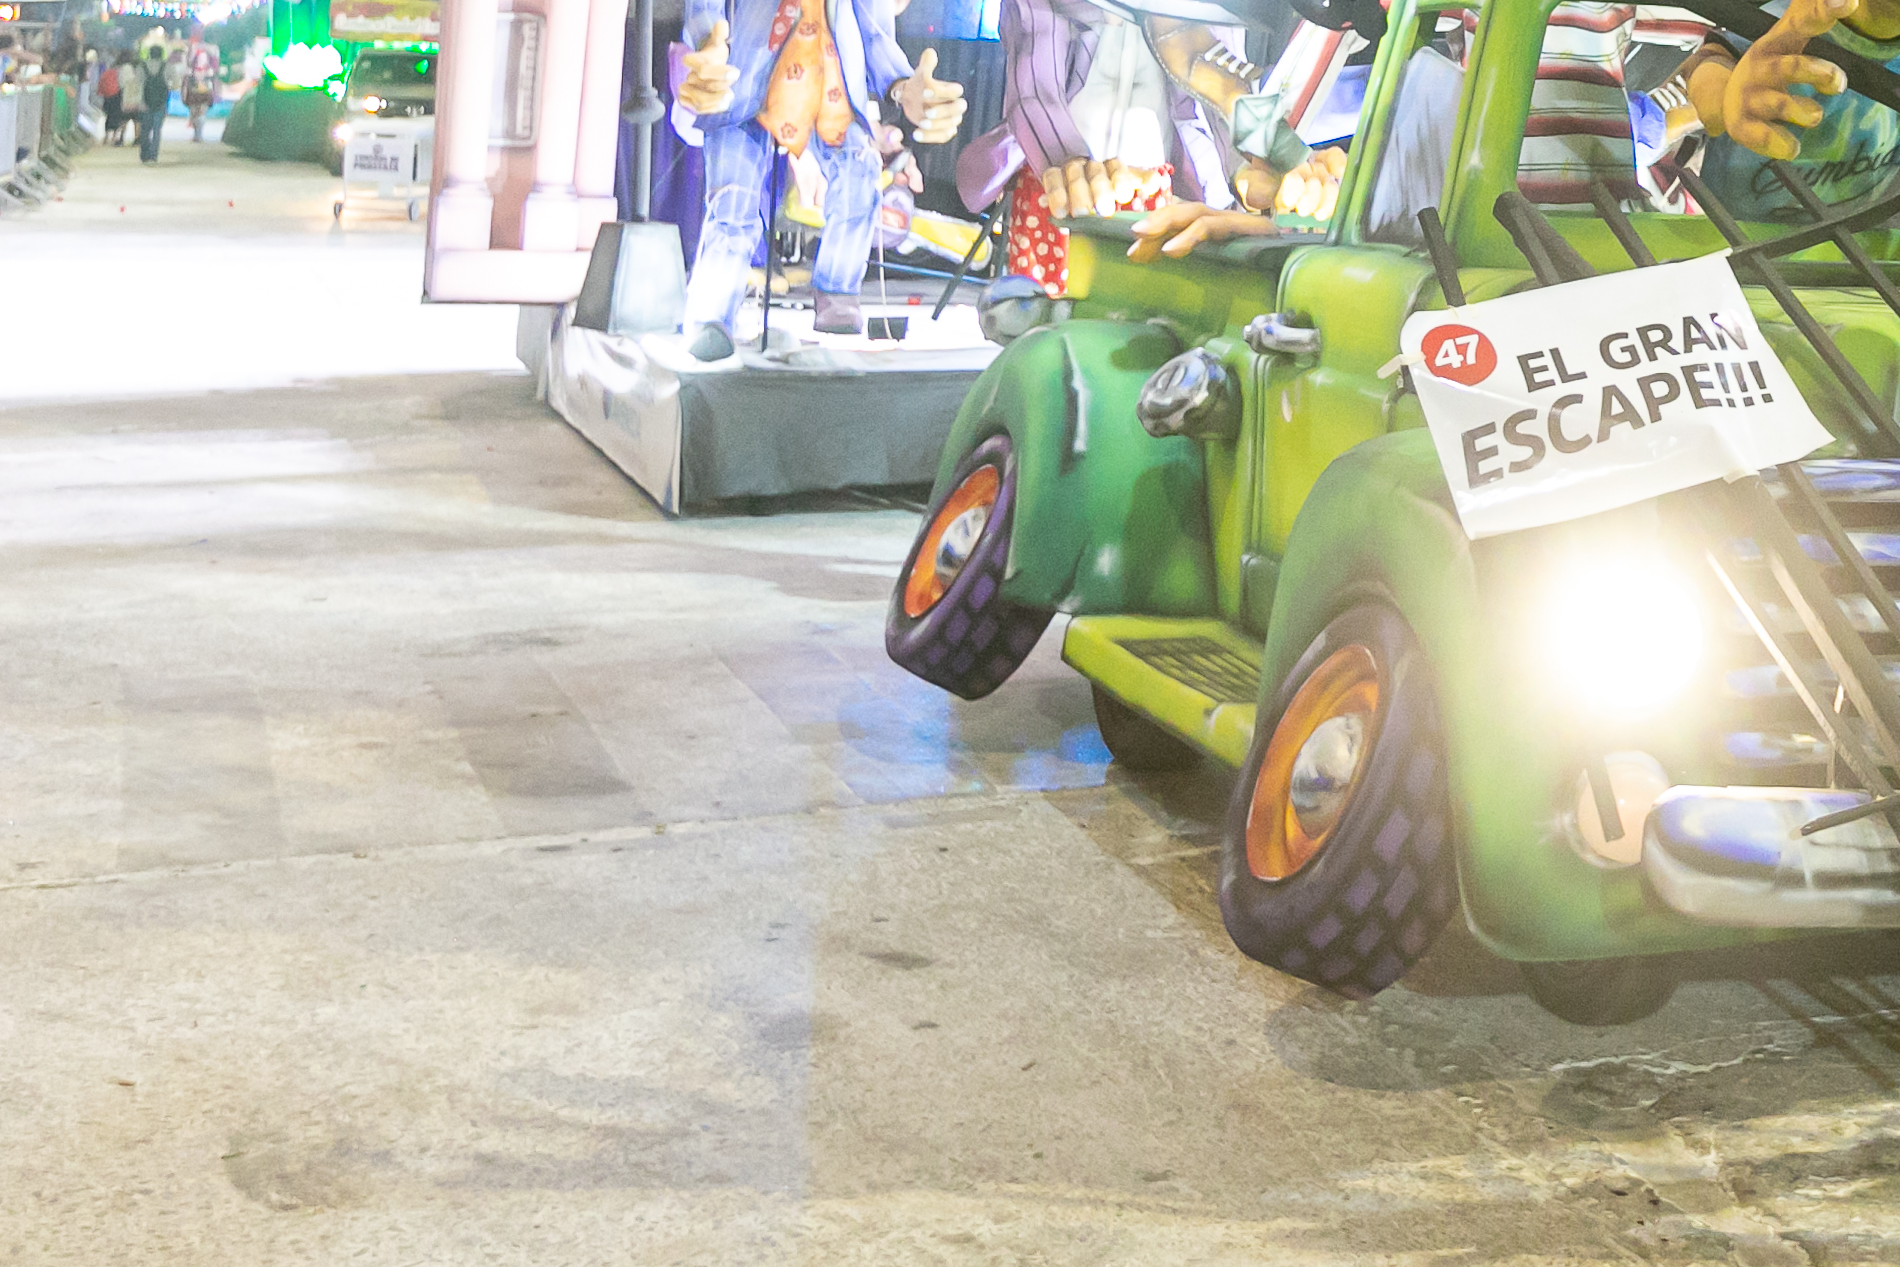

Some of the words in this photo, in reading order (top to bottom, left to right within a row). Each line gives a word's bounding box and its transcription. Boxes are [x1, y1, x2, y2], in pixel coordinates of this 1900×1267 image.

[1433, 333, 1480, 370] 47
[1516, 347, 1588, 393] EL
[1599, 311, 1750, 370] GRAN
[1461, 360, 1775, 489] ESCAPE!!!
